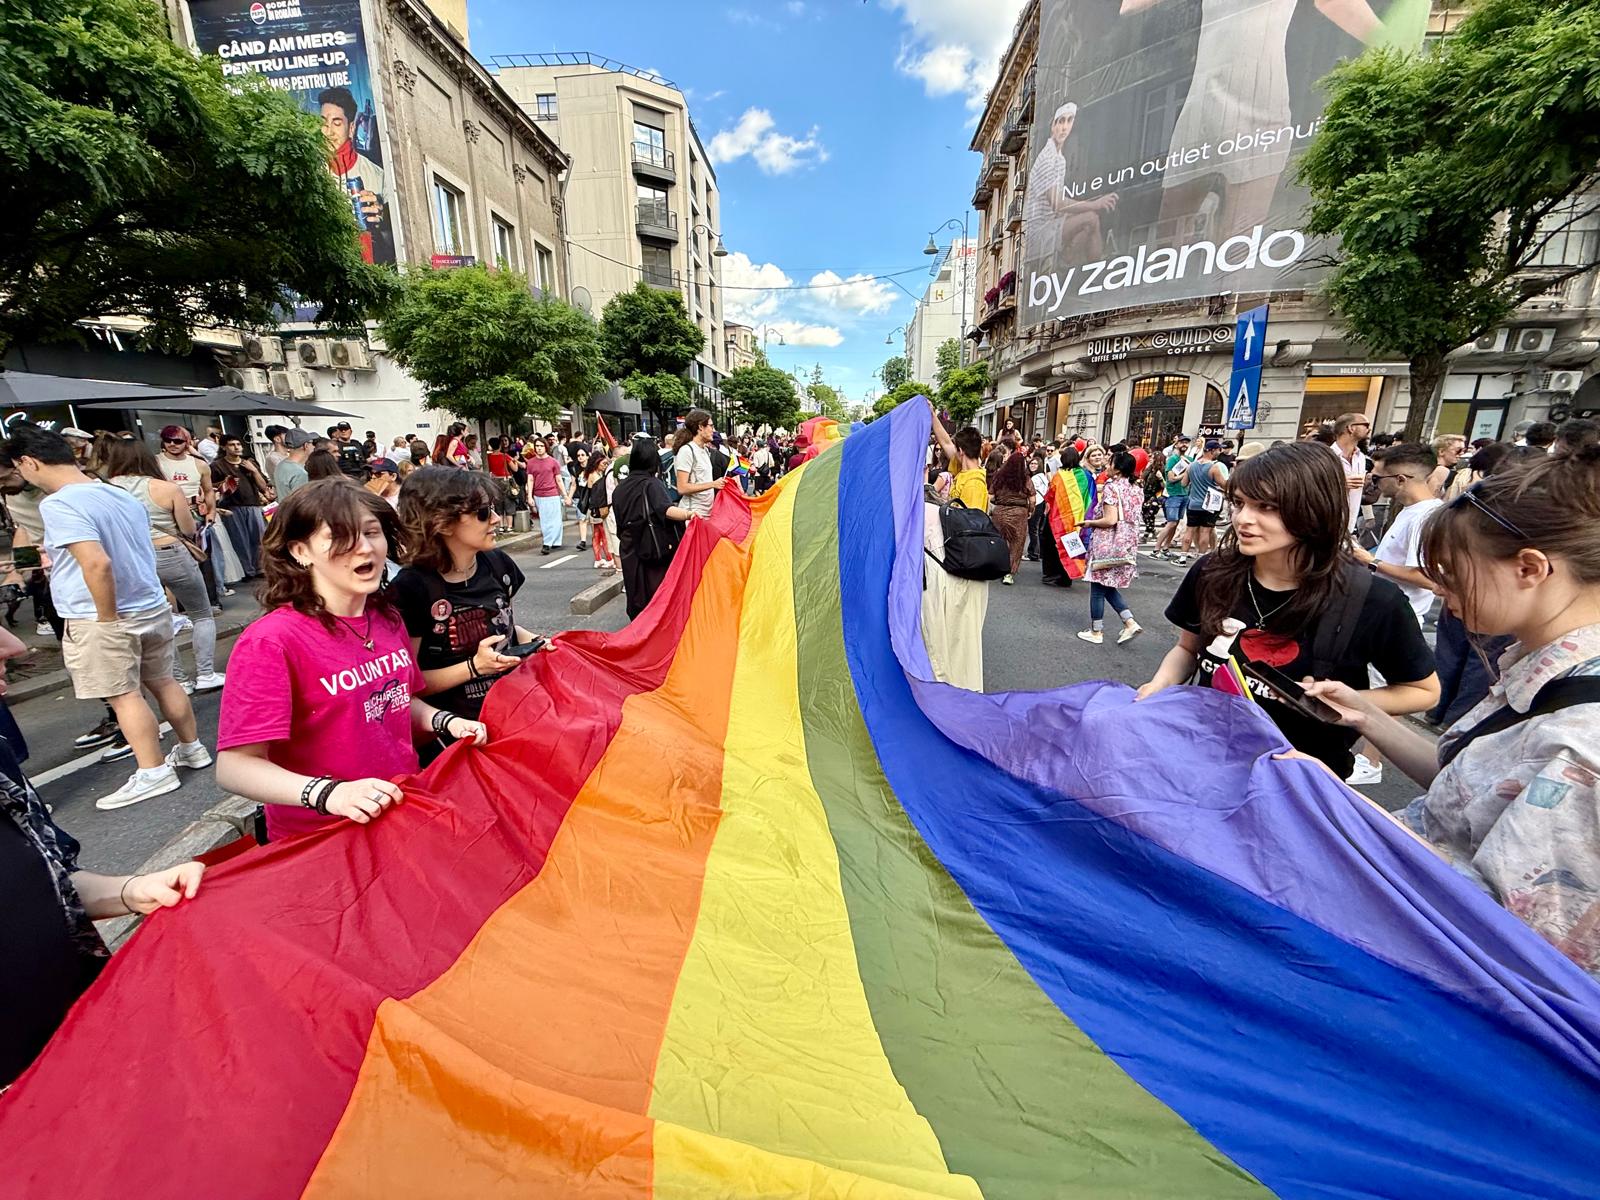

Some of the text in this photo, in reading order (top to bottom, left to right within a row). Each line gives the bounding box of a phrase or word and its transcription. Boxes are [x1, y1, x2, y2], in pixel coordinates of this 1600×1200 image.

[218, 31, 347, 58] CÂND AM MERS
[221, 51, 350, 76] PENTRU LINE-UP,
[291, 73, 327, 91] PENTRU
[328, 71, 352, 87] VIBE.
[1062, 181, 1087, 200] Nu
[1090, 176, 1103, 190] e
[1108, 166, 1134, 185] un
[1140, 142, 1211, 176] outlet
[1028, 268, 1075, 312] by
[1079, 225, 1305, 296] zalando
[1087, 336, 1131, 357] BOILER
[1151, 326, 1232, 349] GUIDO
[1167, 345, 1211, 355] COFFEE
[1091, 353, 1127, 363] COFFEE SHOP
[320, 648, 412, 696] VOLUNTAR
[391, 693, 410, 708] 2026
